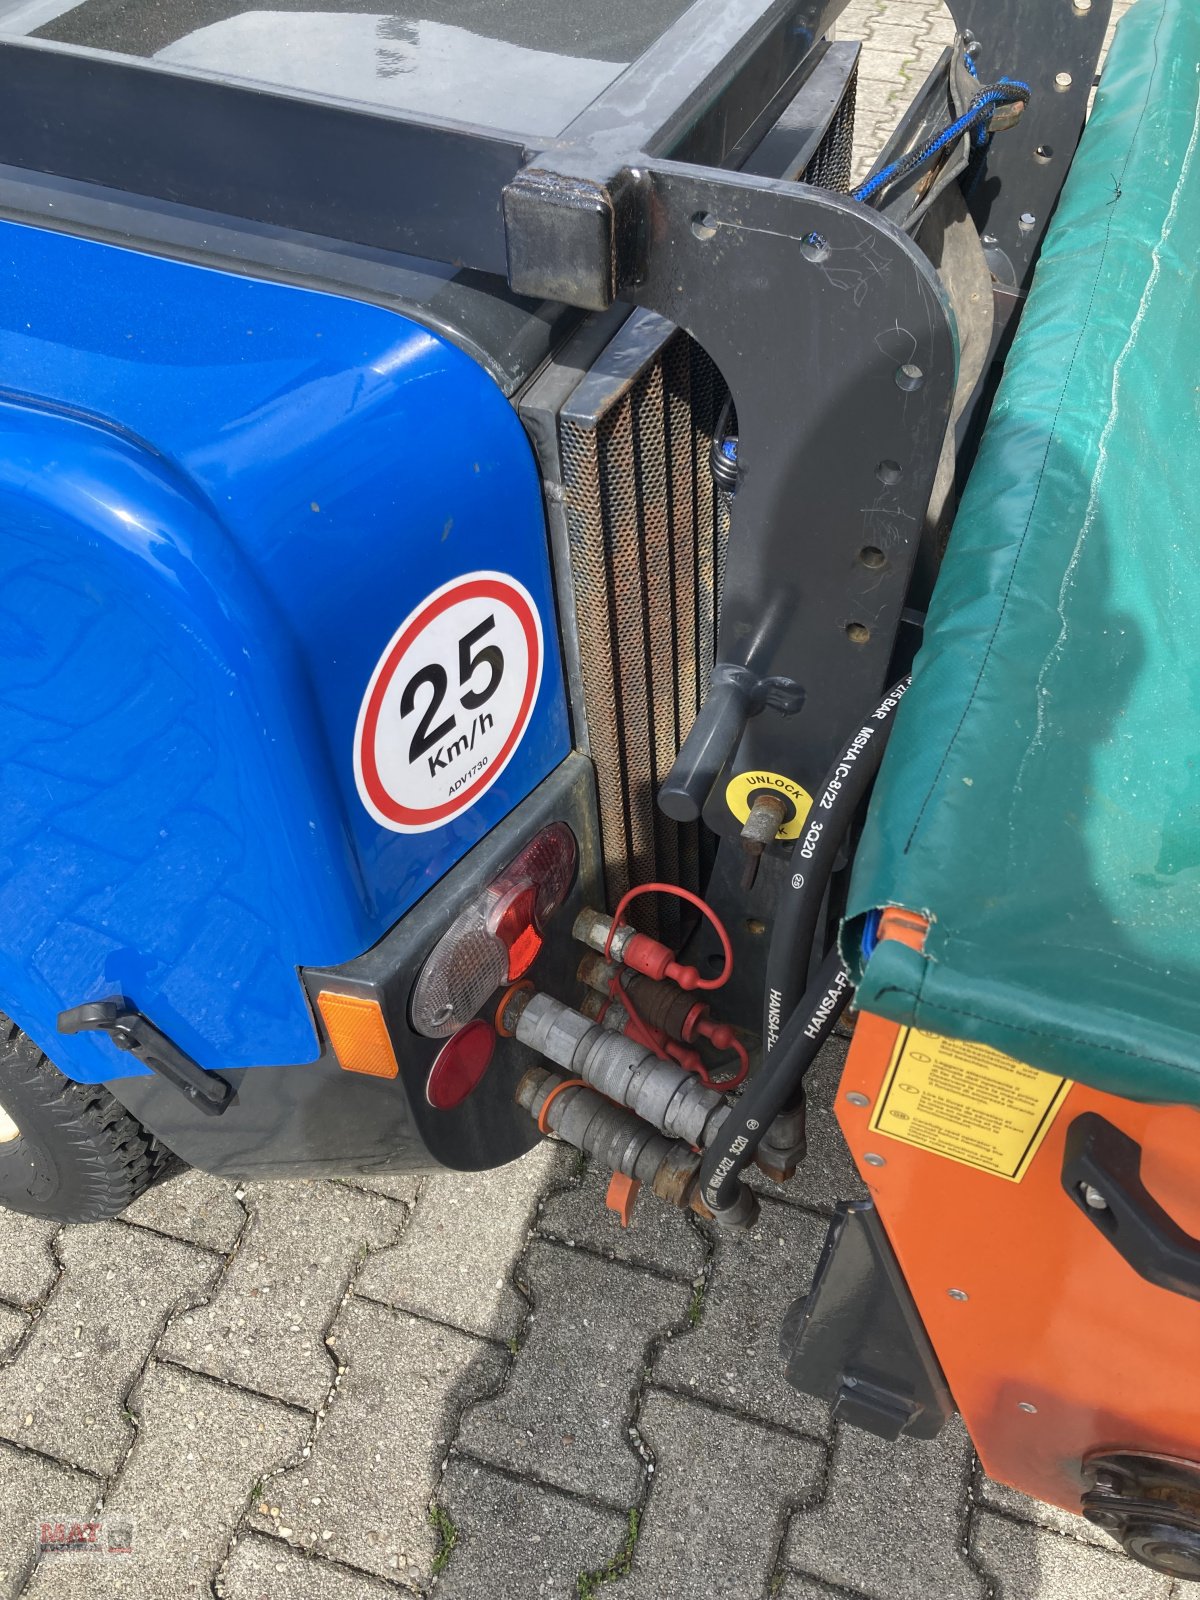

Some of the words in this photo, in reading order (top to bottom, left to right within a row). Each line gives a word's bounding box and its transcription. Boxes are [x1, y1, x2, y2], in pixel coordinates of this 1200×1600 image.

[400, 614, 504, 764] 25
[871, 698, 898, 720] BAR
[428, 712, 494, 777] Km/h
[842, 726, 875, 761] MSHA
[448, 756, 489, 796] ADV1730
[745, 775, 804, 800] UNLOCK
[819, 763, 852, 809] IC-8/22
[800, 821, 824, 859] 3Q20
